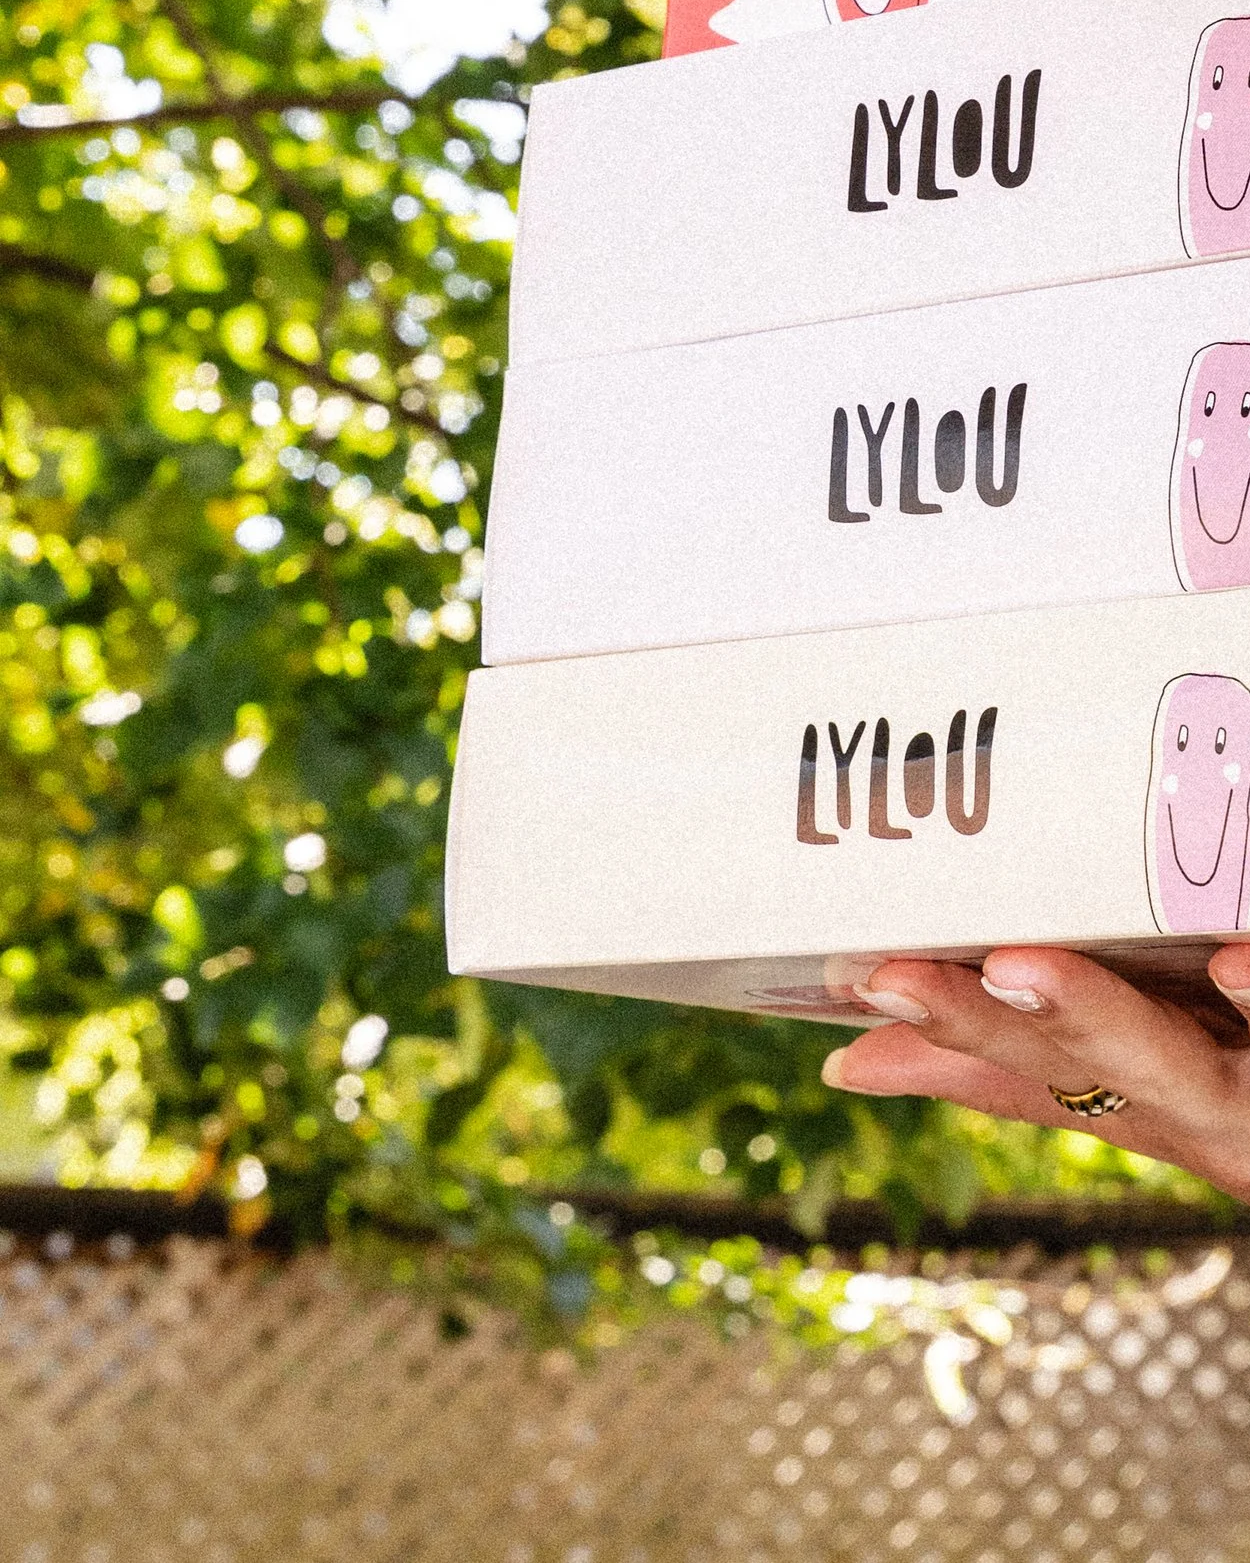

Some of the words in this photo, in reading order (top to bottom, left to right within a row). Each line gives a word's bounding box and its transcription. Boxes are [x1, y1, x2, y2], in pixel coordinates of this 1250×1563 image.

[848, 69, 1041, 213] LYLOU
[829, 383, 1028, 524] LYLOU
[798, 707, 997, 845] LYLOU
